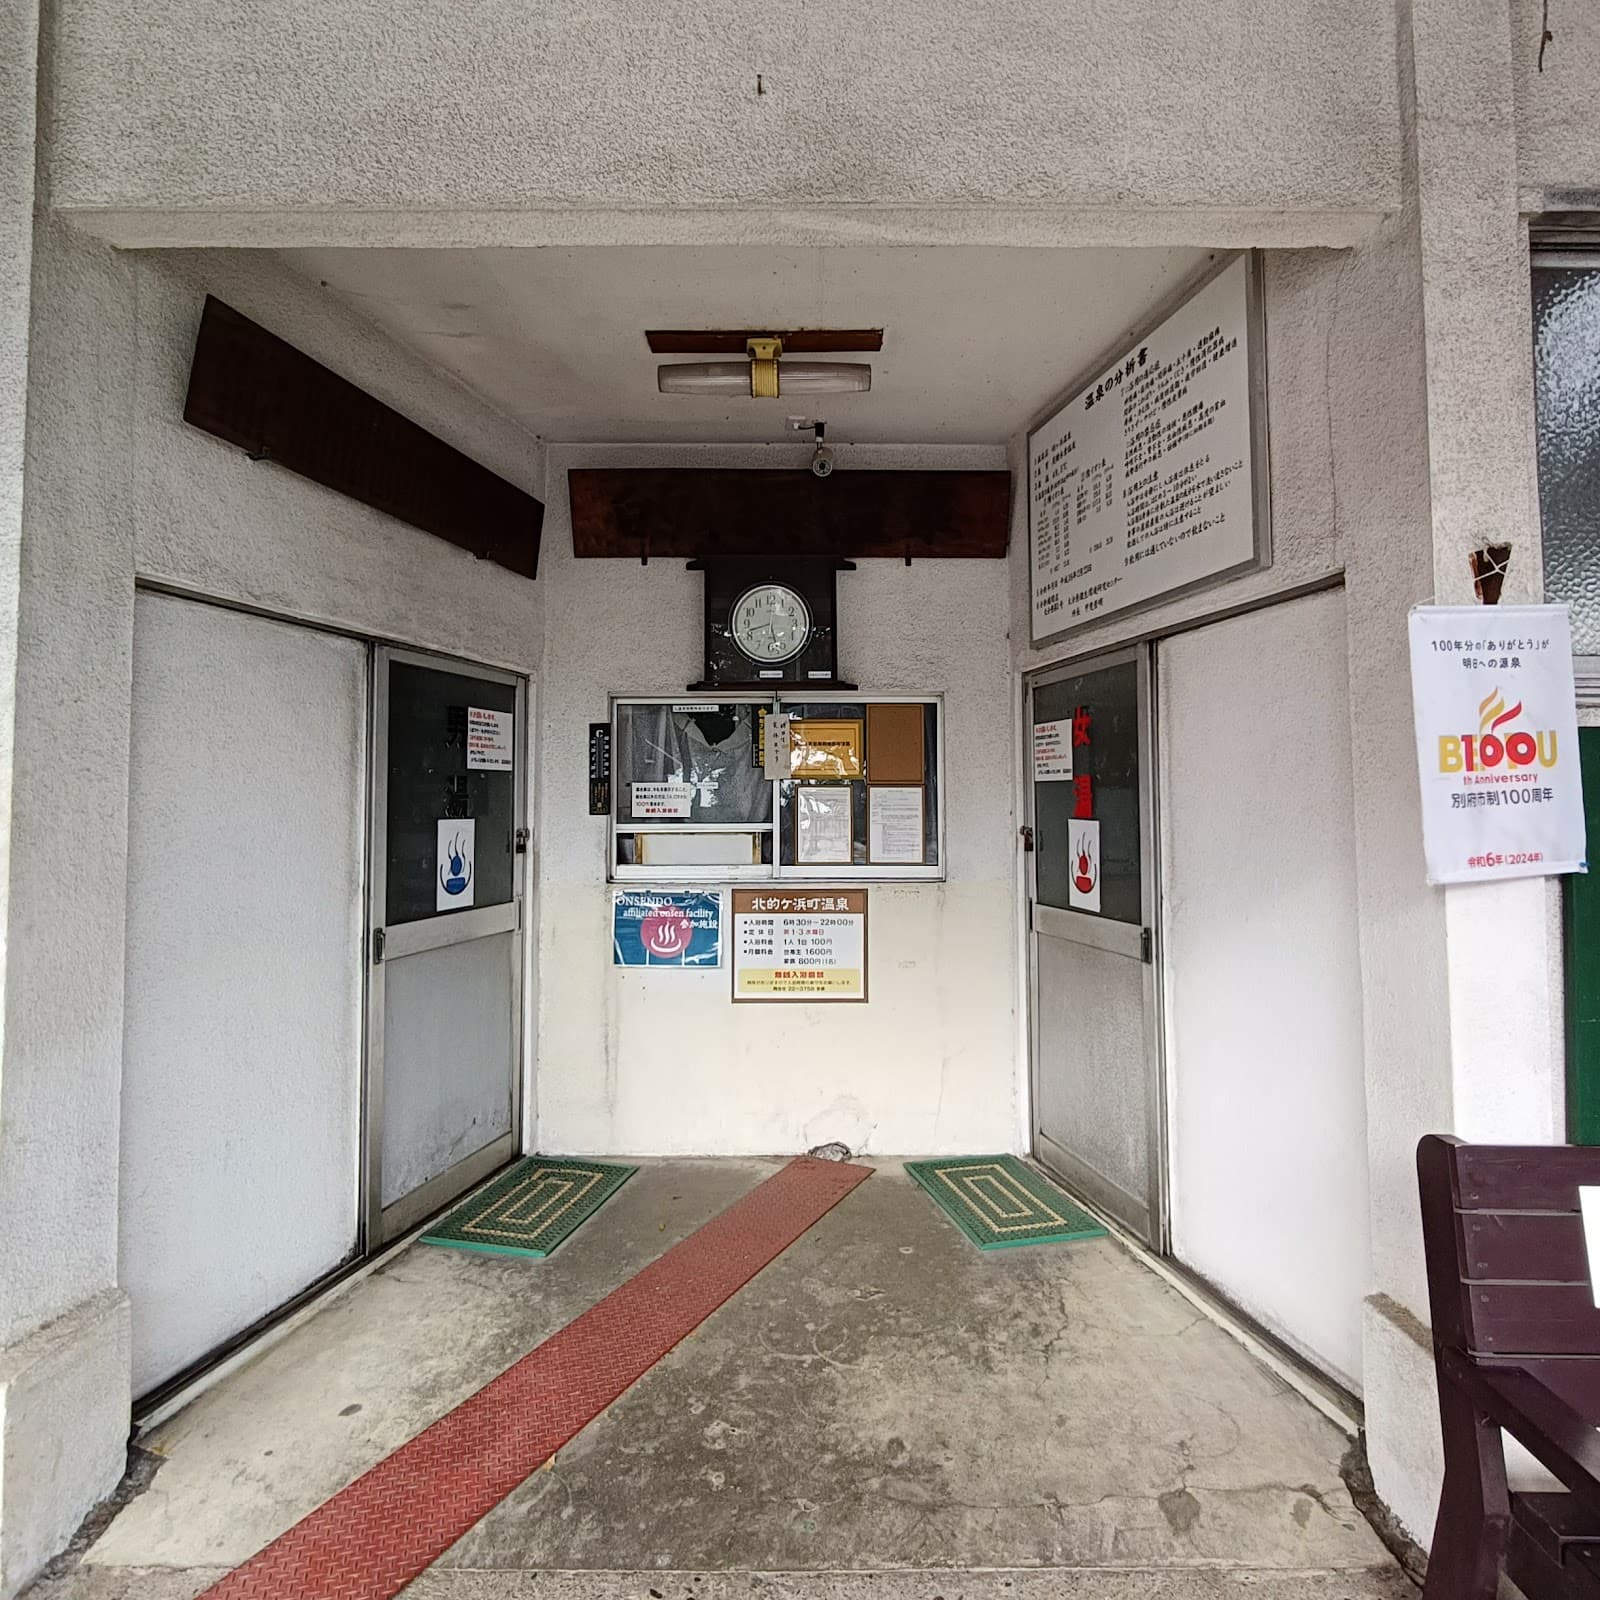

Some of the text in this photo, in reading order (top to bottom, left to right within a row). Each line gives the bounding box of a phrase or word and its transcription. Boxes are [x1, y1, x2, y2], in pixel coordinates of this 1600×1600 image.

[1085, 347, 1148, 410] 温泉の分析書
[1462, 657, 1521, 669] 明日への源泉
[1474, 773, 1538, 785] Anniversary
[1452, 788, 1554, 809] 別府市制100周年
[616, 896, 672, 906] ONSENDO
[624, 908, 714, 919] affiliated onsen facility
